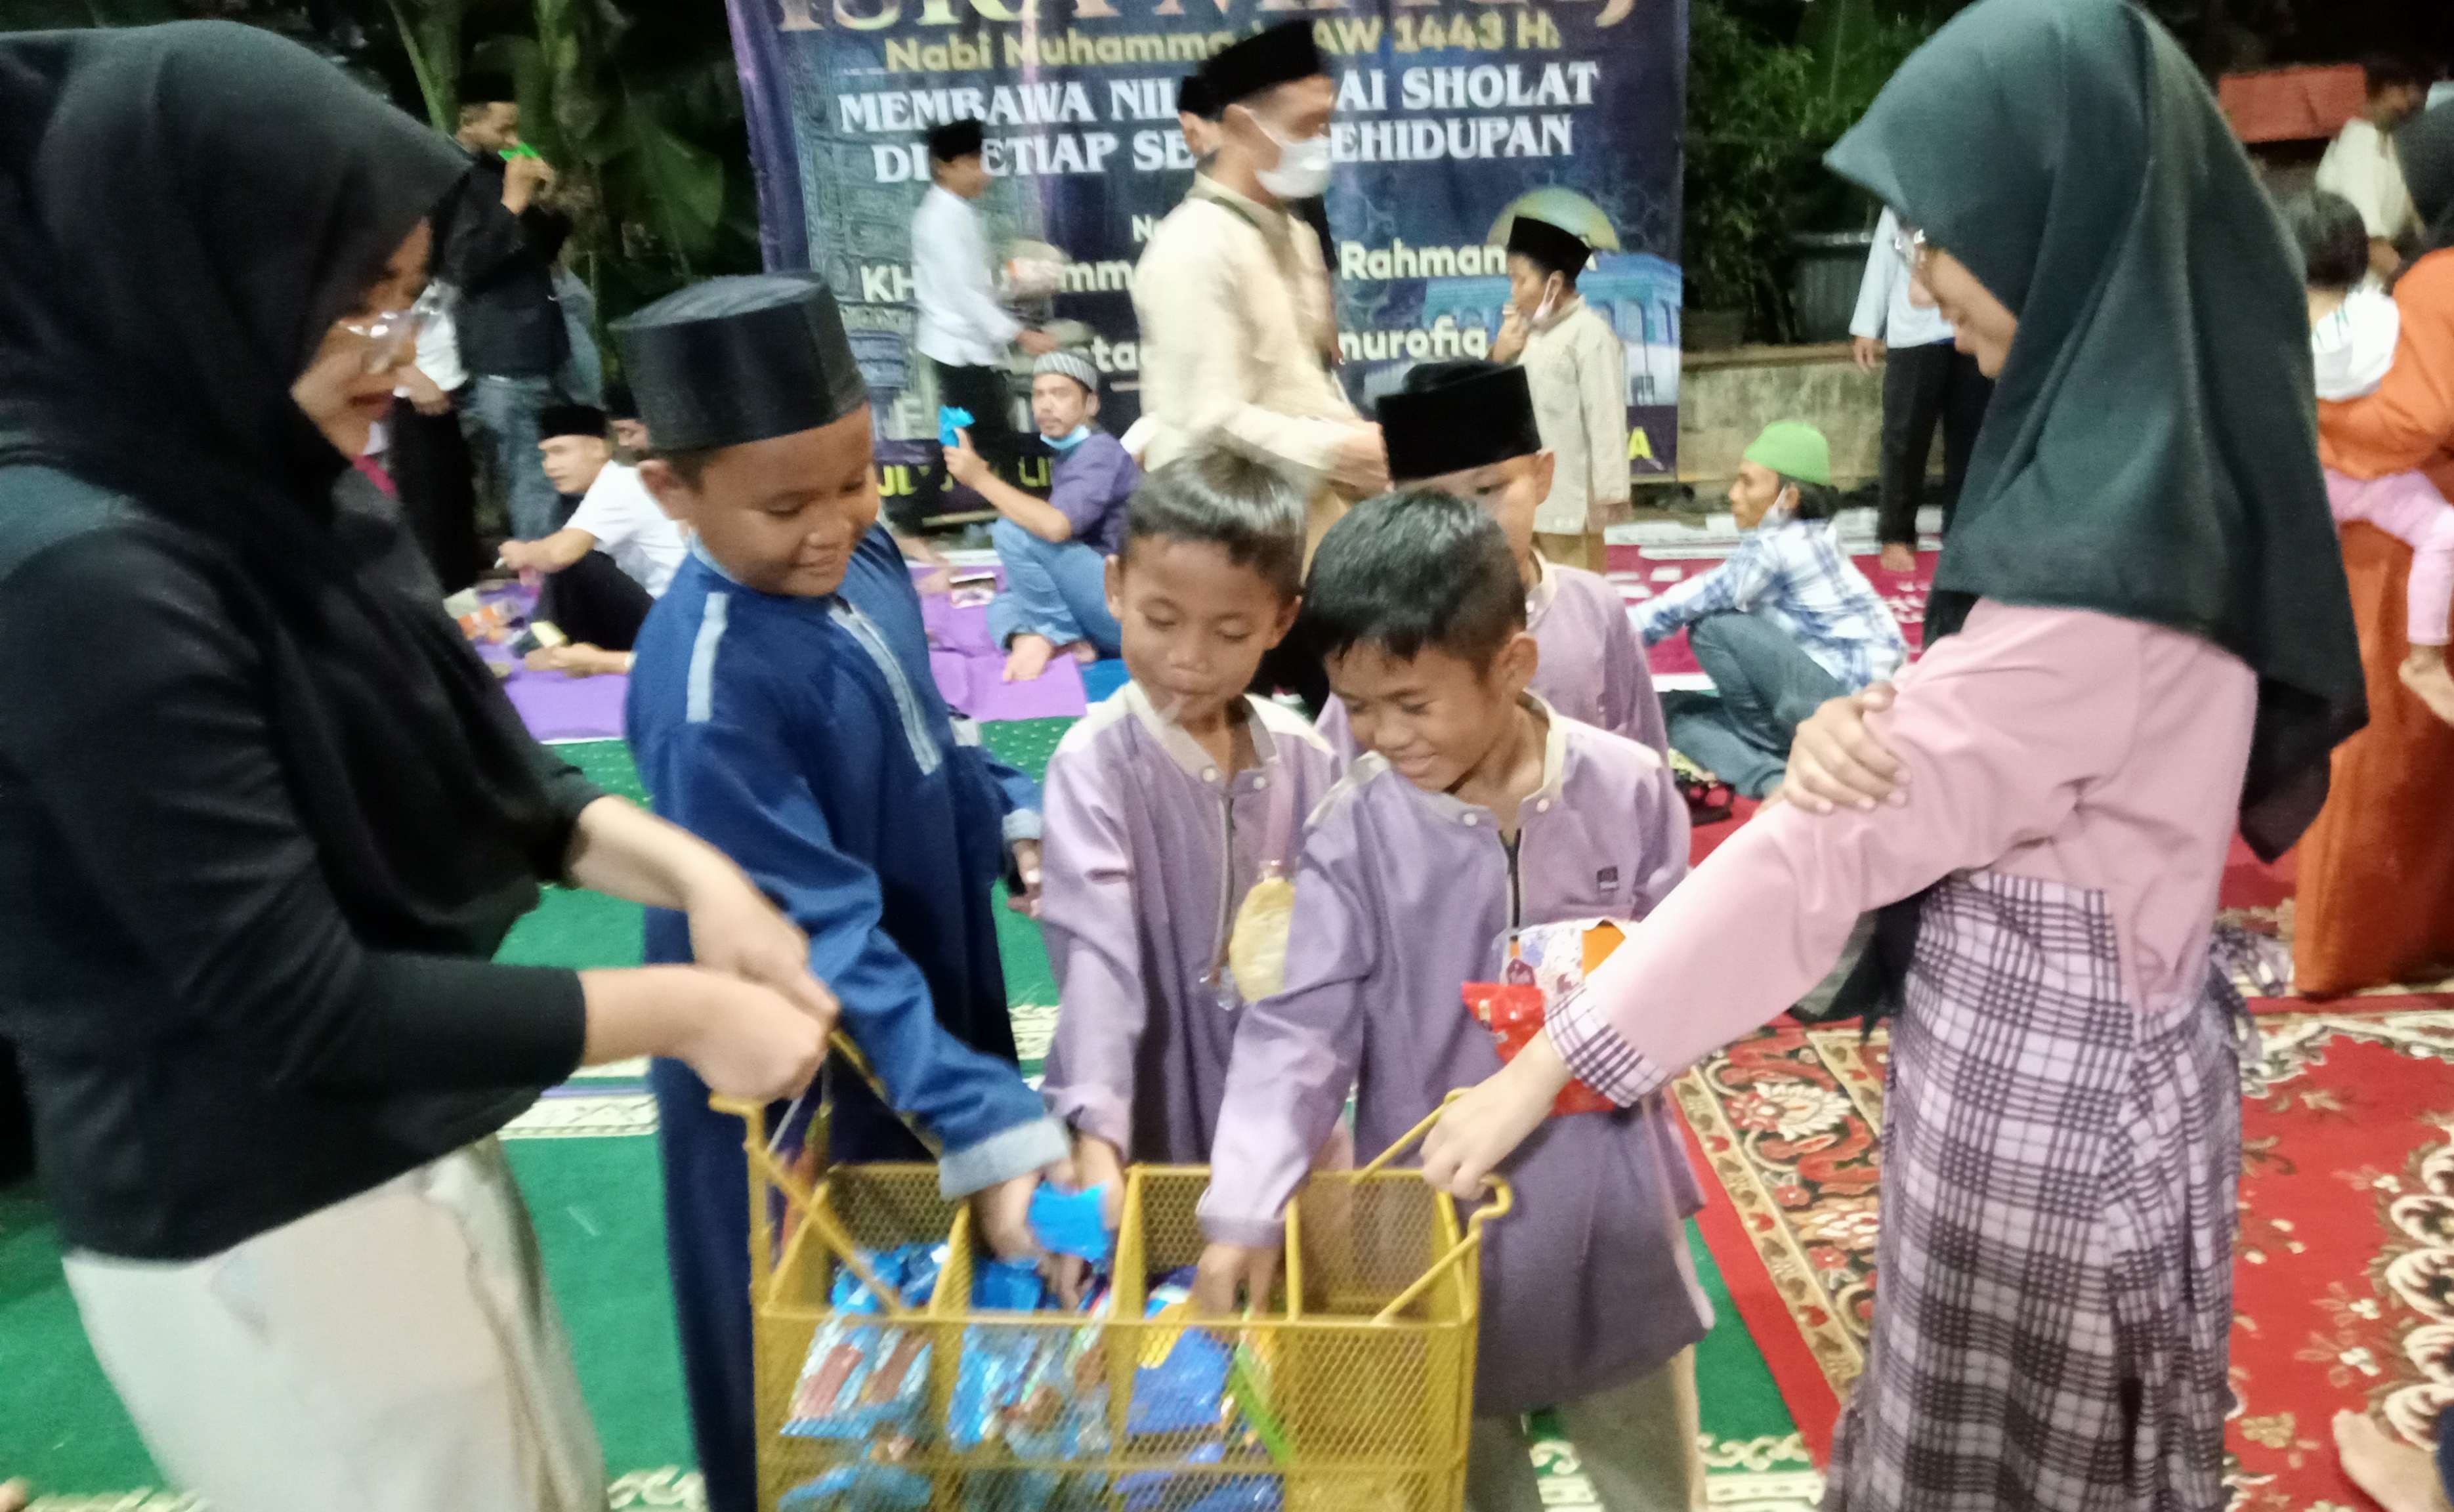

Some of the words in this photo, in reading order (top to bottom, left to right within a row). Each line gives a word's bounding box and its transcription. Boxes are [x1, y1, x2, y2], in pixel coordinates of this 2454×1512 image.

[885, 31, 993, 72] Nabi
[1313, 16, 1382, 55] AW
[1394, 12, 1501, 52] 1443
[1402, 62, 1599, 109] SHOLAT
[872, 142, 931, 184] DI
[981, 132, 1118, 177] ETIAP
[1331, 115, 1574, 162] EHIDUPAN
[1340, 236, 1508, 280] Rahman
